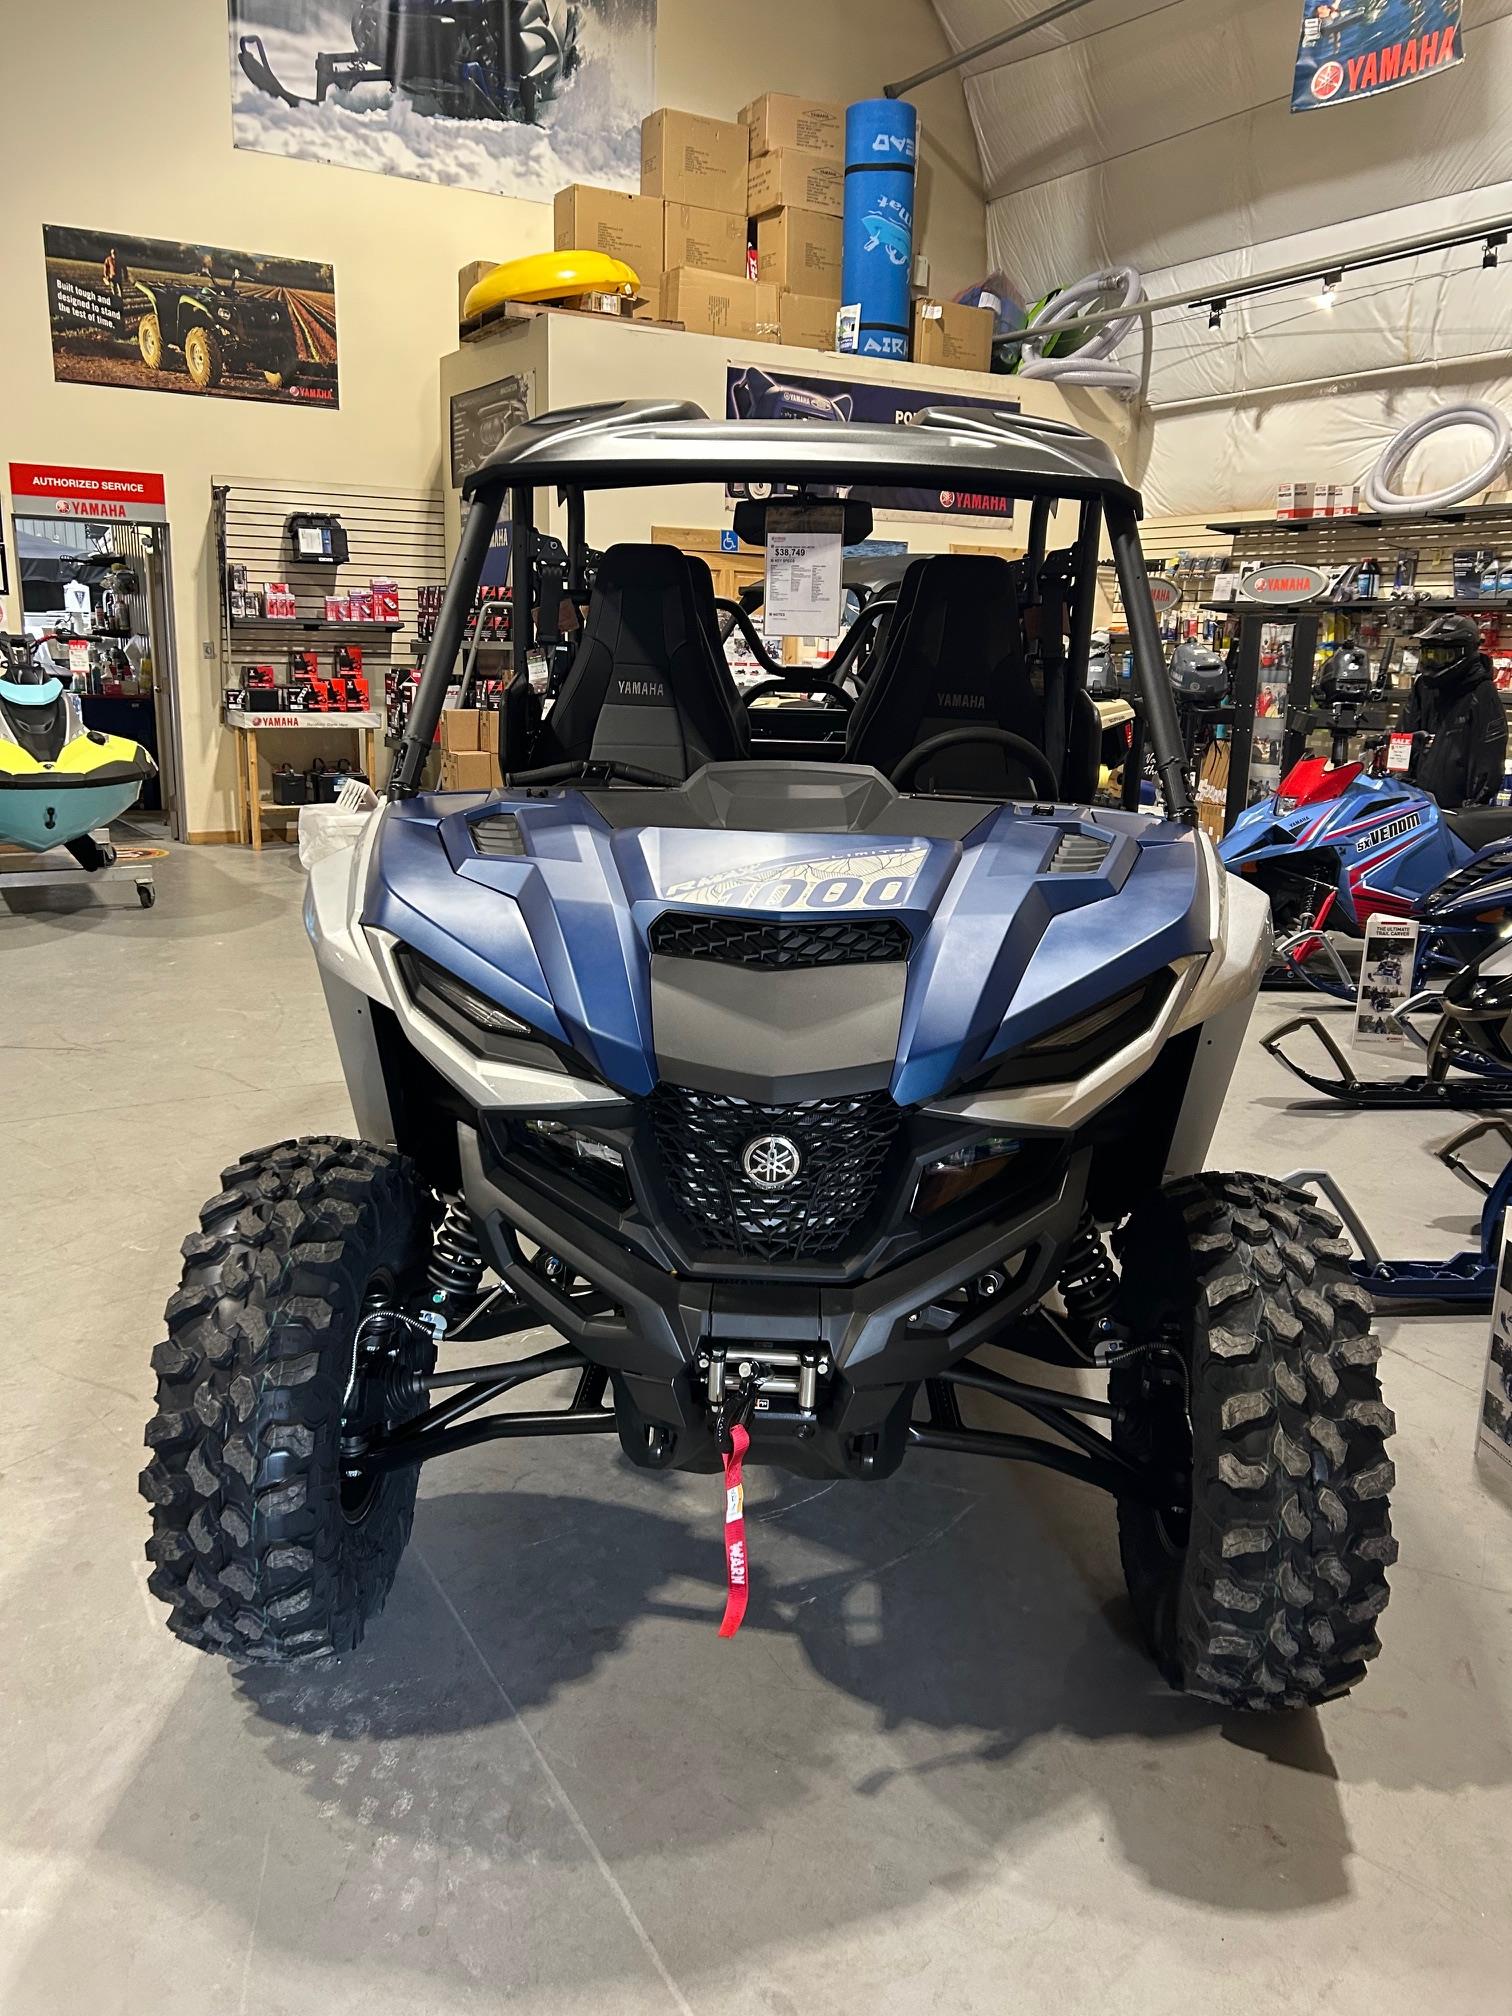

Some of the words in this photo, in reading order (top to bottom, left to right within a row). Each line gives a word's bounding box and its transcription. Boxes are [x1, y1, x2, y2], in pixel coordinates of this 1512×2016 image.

[1348, 26, 1455, 92] YAMAHA
[56, 279, 74, 294] Built
[75, 286, 96, 301] tough
[97, 295, 111, 306] and
[57, 291, 90, 309] designed
[92, 303, 99, 313] to
[101, 307, 120, 320] stand
[58, 302, 71, 314] the
[72, 307, 87, 319] test
[87, 314, 95, 322] of
[97, 316, 115, 329] time.
[300, 387, 332, 400] YAMAHA
[790, 394, 810, 405] YAMAHA
[32, 476, 99, 490] AUTHORIZED
[101, 481, 144, 493] SERVICE
[71, 501, 126, 518] YAMAHA
[956, 493, 1007, 512] YAMAHA
[775, 548, 806, 557] $38,749
[1267, 577, 1311, 592] YAMAHA
[618, 680, 664, 697] YAMAHA
[937, 692, 985, 709] YAMAHA
[263, 716, 299, 727] YAMAHA
[1289, 815, 1310, 827] YAMAHA
[1369, 811, 1422, 844] VENOM
[716, 876, 915, 909] 1000
[731, 1541, 745, 1585] WARN
